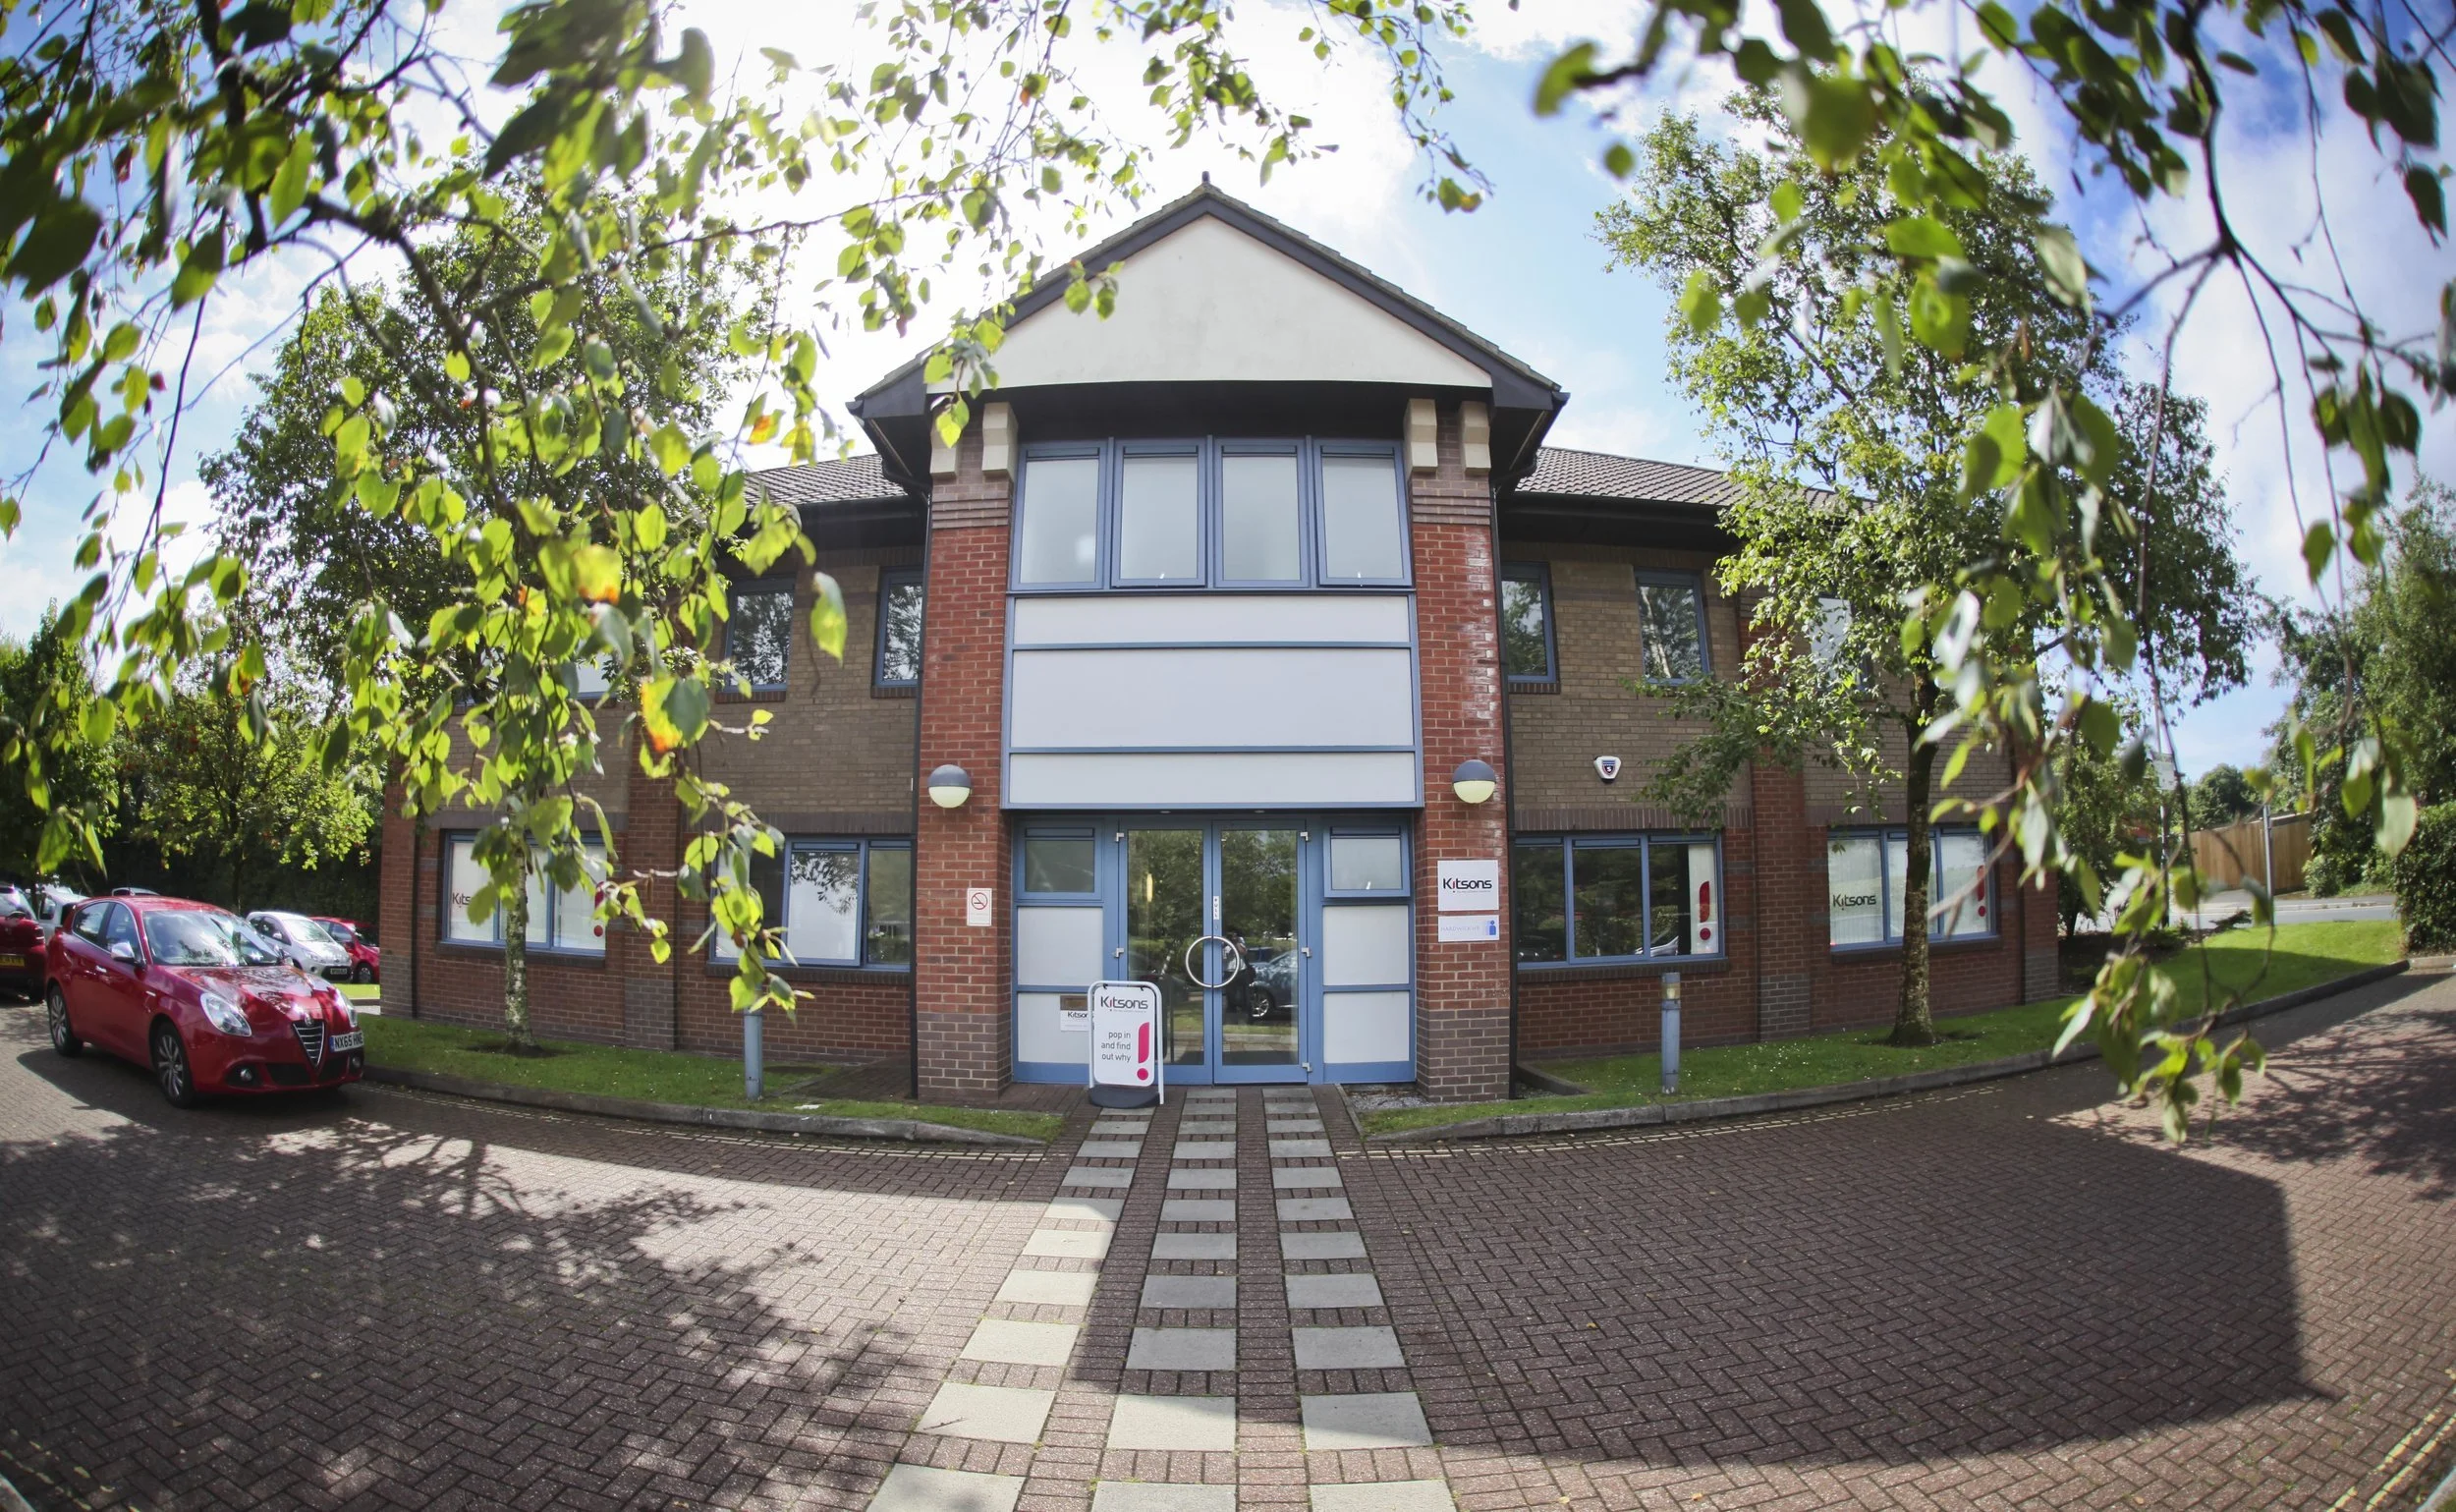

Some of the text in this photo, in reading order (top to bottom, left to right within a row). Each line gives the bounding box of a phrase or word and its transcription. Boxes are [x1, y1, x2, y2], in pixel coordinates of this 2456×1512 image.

[1442, 877, 1492, 893] Kitsons
[452, 892, 472, 908] Kits
[1832, 894, 1877, 911] Kitsons
[1100, 995, 1148, 1011] Kitsons
[1116, 1041, 1131, 1050] find
[1115, 1053, 1131, 1063] why
